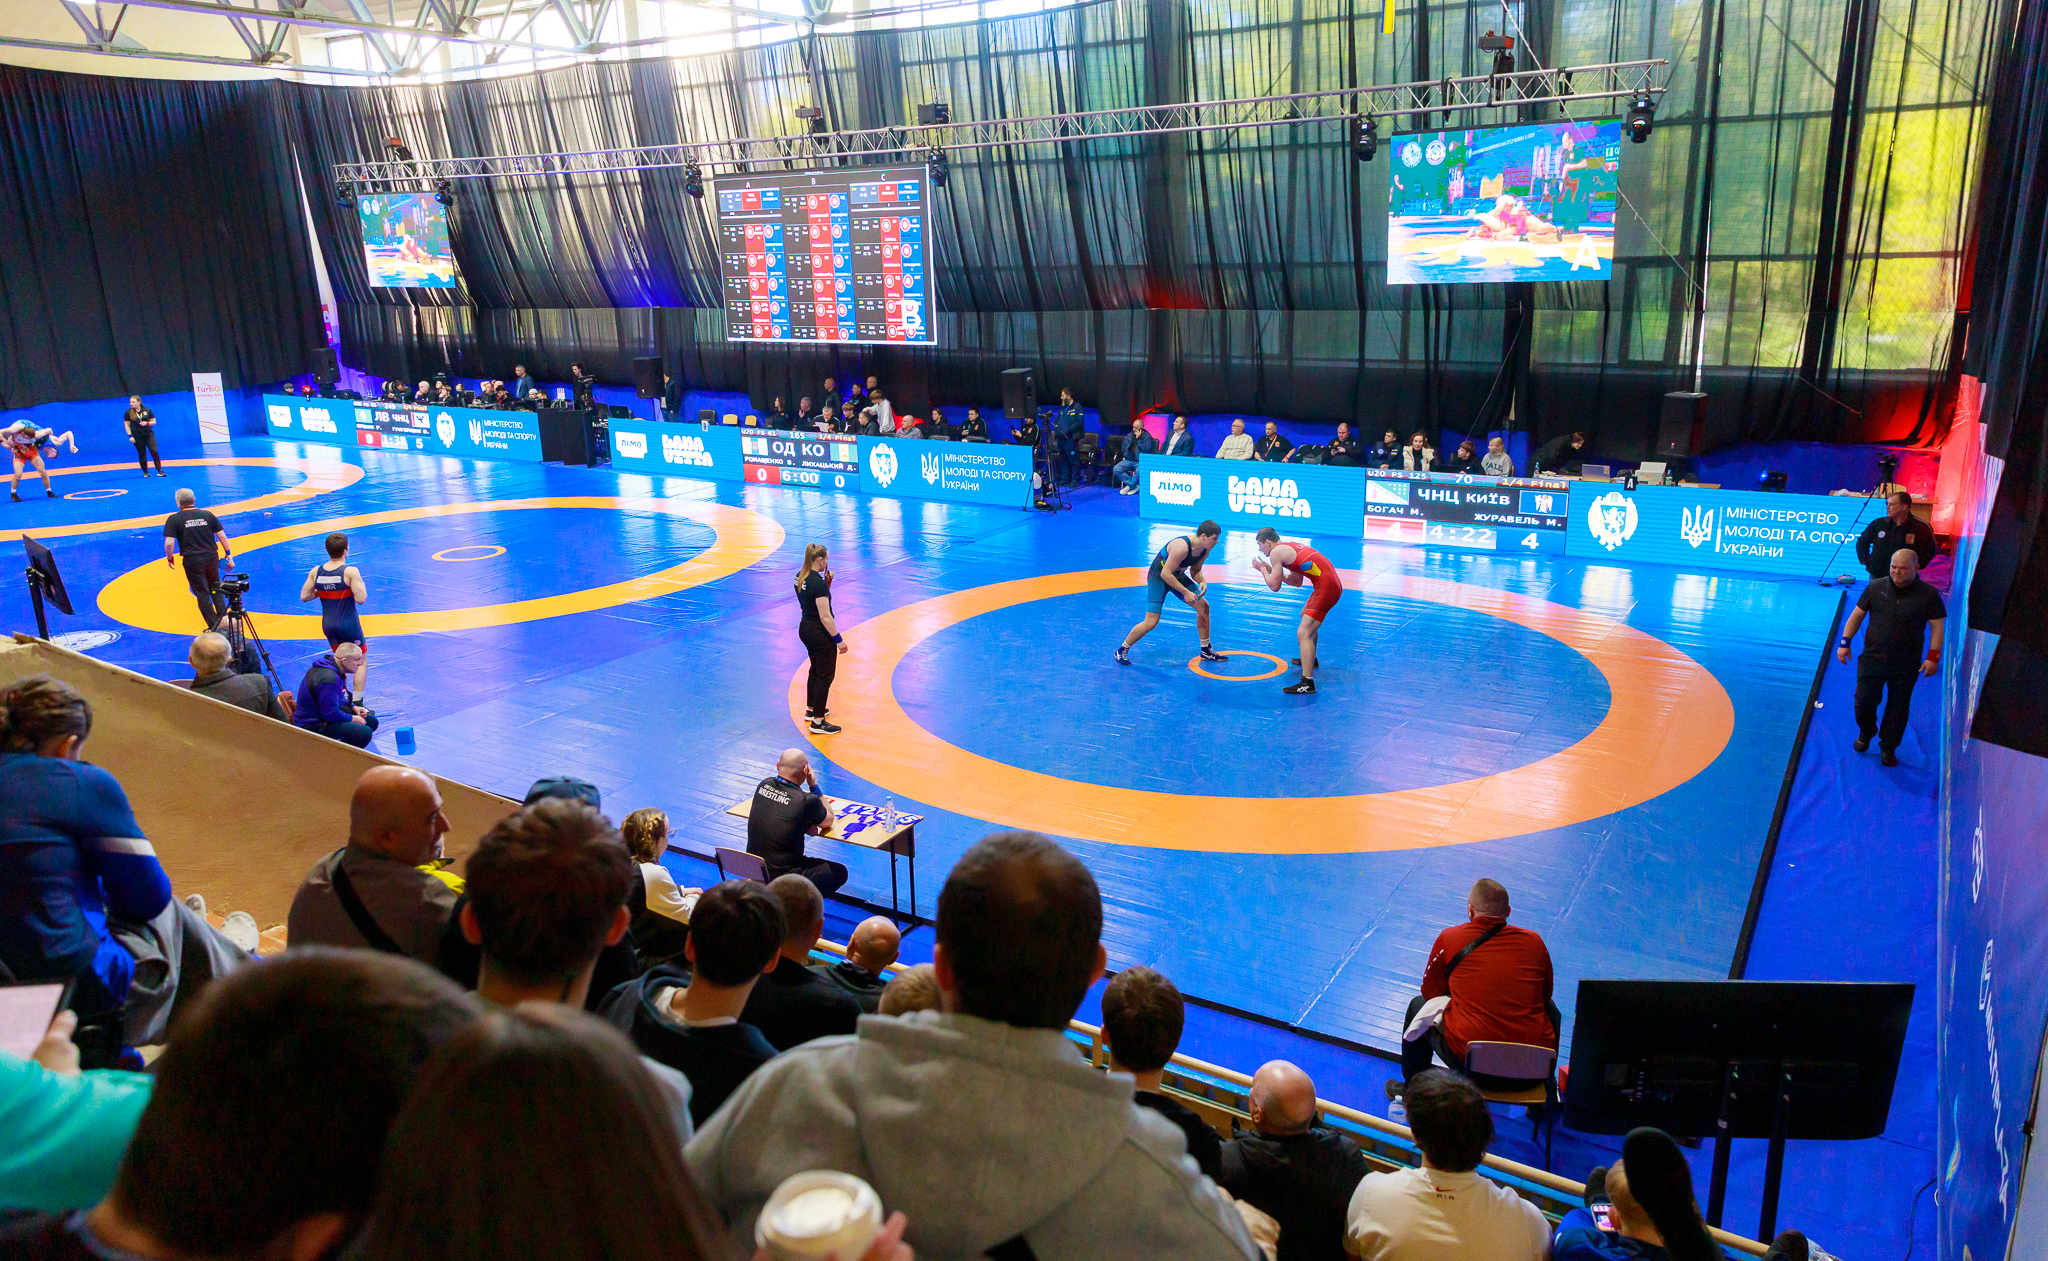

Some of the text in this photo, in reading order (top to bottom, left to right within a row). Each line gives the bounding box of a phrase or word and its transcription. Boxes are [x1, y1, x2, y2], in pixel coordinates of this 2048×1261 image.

[1570, 235, 1602, 271] A
[900, 299, 922, 329] B
[374, 411, 390, 422] ЛВ
[392, 414, 410, 424] ЧНЦ
[484, 420, 523, 429] МІНІСТЕРСТВО
[366, 434, 374, 444] 9
[382, 435, 406, 446] 1:38
[485, 430, 506, 439] МОЛОДІ
[514, 432, 536, 441] СПОРТУ
[790, 432, 805, 440] 165
[835, 434, 856, 442] Final
[416, 438, 424, 449] 5
[772, 442, 796, 456] ОД
[802, 443, 824, 456] КО
[945, 454, 1006, 466] МІНІСТЕРСТВО
[757, 468, 766, 481] 0
[782, 470, 818, 484] 6:00
[946, 467, 1026, 482] МОЛОДІ ТА СПОРТУ
[1368, 470, 1386, 478] U20
[1408, 472, 1427, 480] 125
[1456, 474, 1473, 484] 70
[834, 475, 845, 488] 0
[946, 480, 980, 491] УКРАЇНИ
[1158, 478, 1192, 492] лімо
[1502, 478, 1566, 488] 1/4 Final
[1626, 478, 1634, 489] A
[1418, 488, 1460, 506] ЧНЦ
[1368, 506, 1424, 516] БОГАЧ М.
[1726, 506, 1839, 525] МІНІСТЕРСТВО
[1474, 513, 1562, 528] ЖУРАВЕЛЬ М.
[1386, 522, 1402, 538] 4
[1430, 526, 1492, 544] 4:22
[1724, 526, 1784, 540] МОЛОДІ
[1788, 530, 1806, 541] ТА
[1521, 533, 1539, 550] 4
[1722, 542, 1784, 558] УКРАЇНИ
[758, 786, 790, 806] WRESTLING
[860, 806, 876, 815] 2
[899, 815, 918, 823] 5
